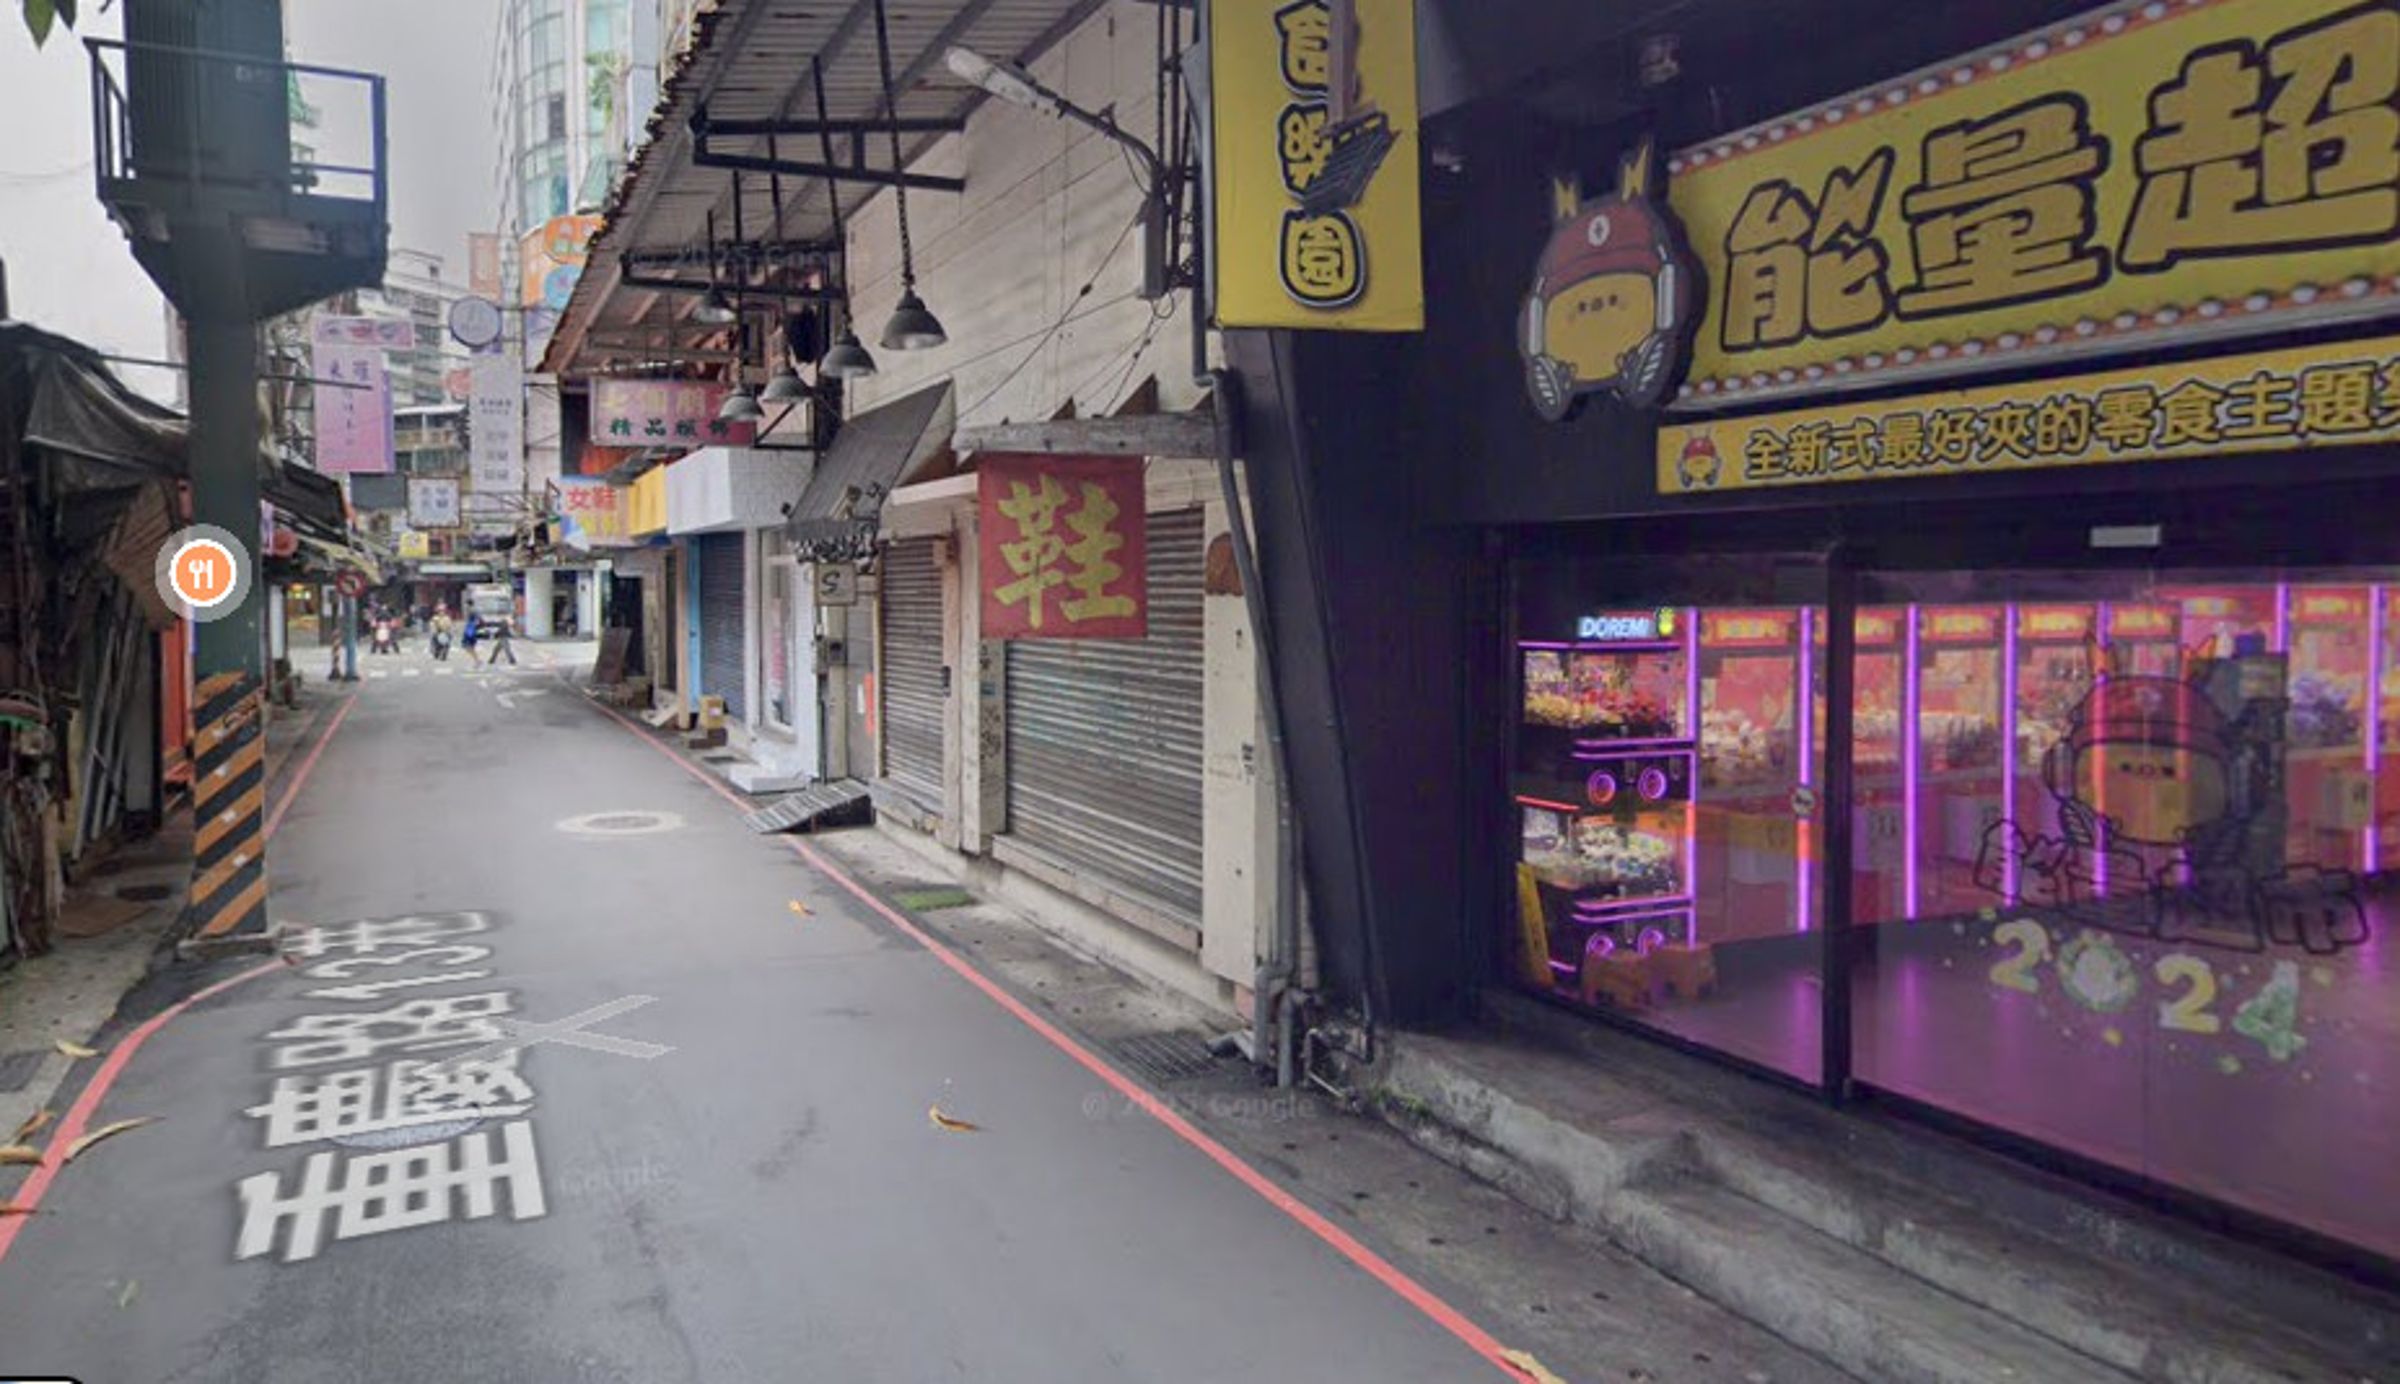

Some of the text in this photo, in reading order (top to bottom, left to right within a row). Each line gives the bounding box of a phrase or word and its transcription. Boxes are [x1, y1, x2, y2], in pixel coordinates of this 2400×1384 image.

[1720, 0, 2400, 353] 能量超
[566, 486, 617, 511] 女鞋
[993, 472, 1138, 630] 鞋
[1579, 618, 1650, 638] DOREMI
[1988, 917, 2308, 1062] 2024
[236, 910, 547, 1263] 重慶路13巷
